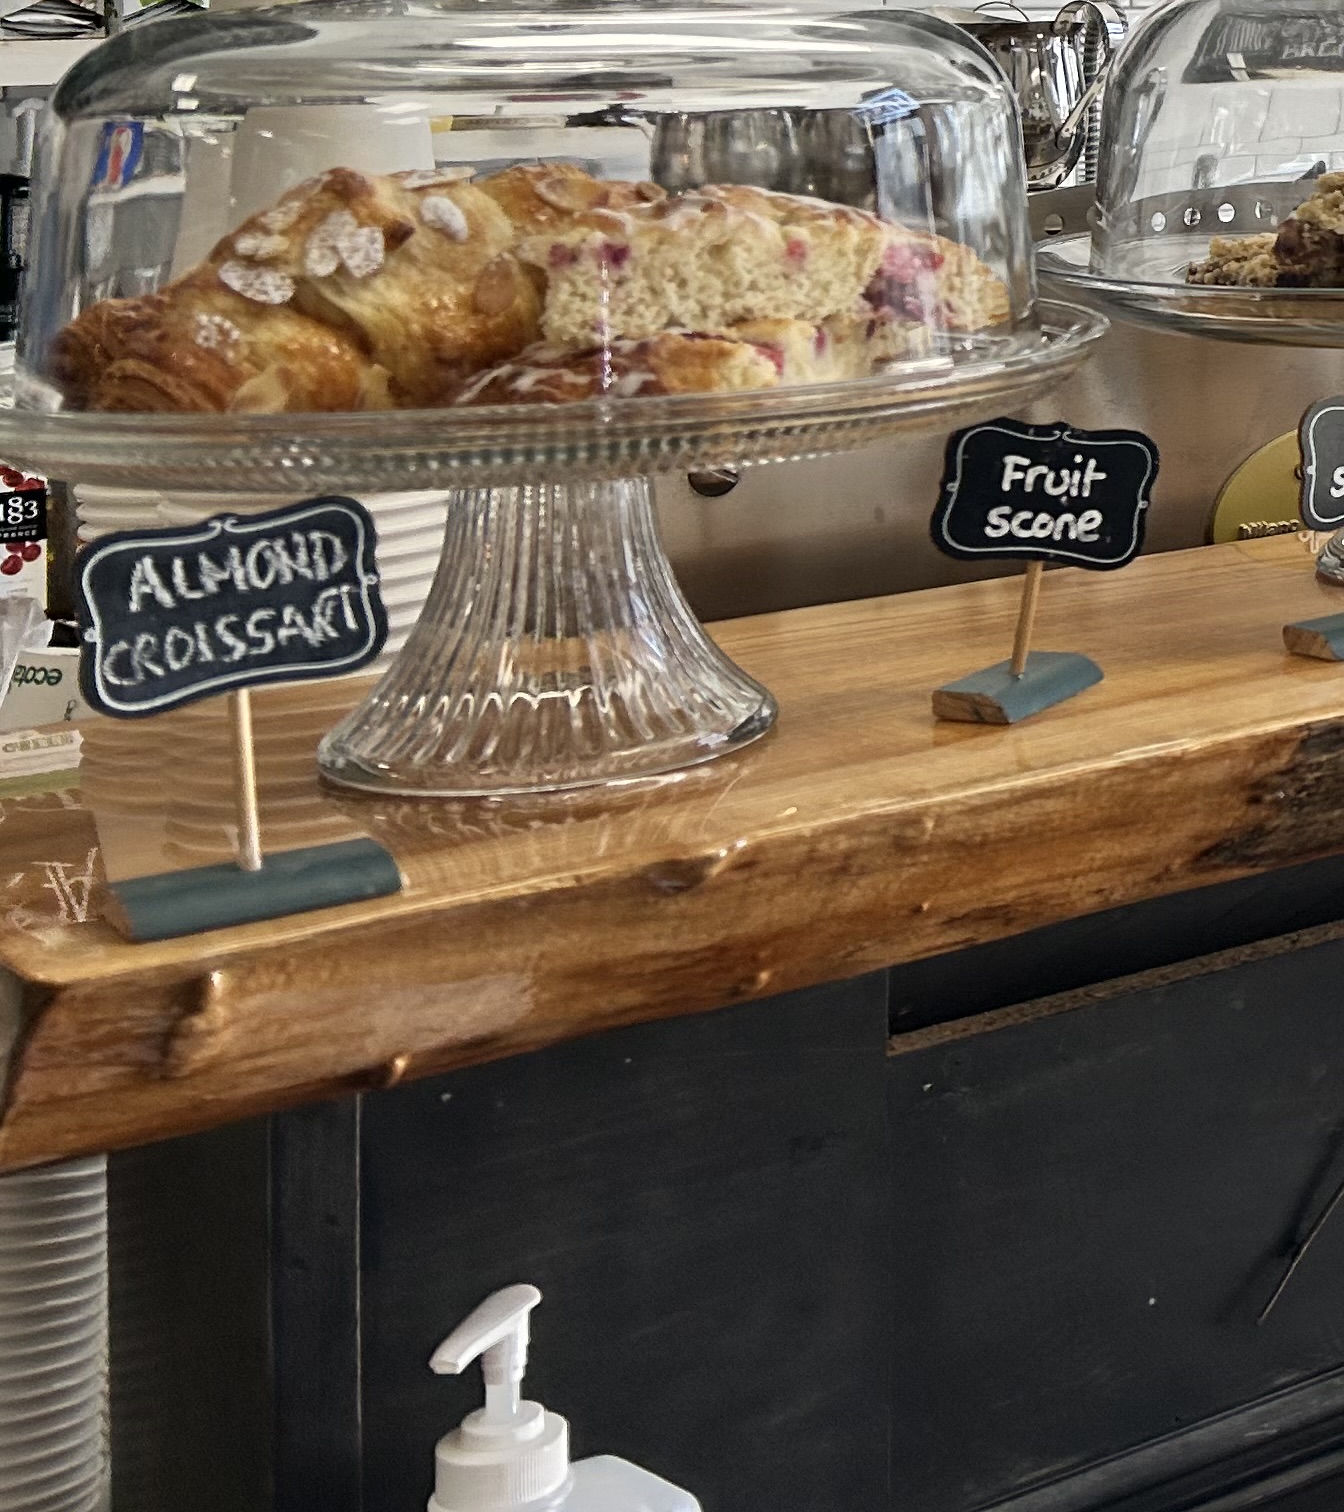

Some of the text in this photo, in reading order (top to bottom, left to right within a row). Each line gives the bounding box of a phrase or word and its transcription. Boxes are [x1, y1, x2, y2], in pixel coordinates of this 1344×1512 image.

[1001, 455, 1107, 498] Fruit
[984, 505, 1104, 542] scone
[129, 530, 348, 613] ALMOND
